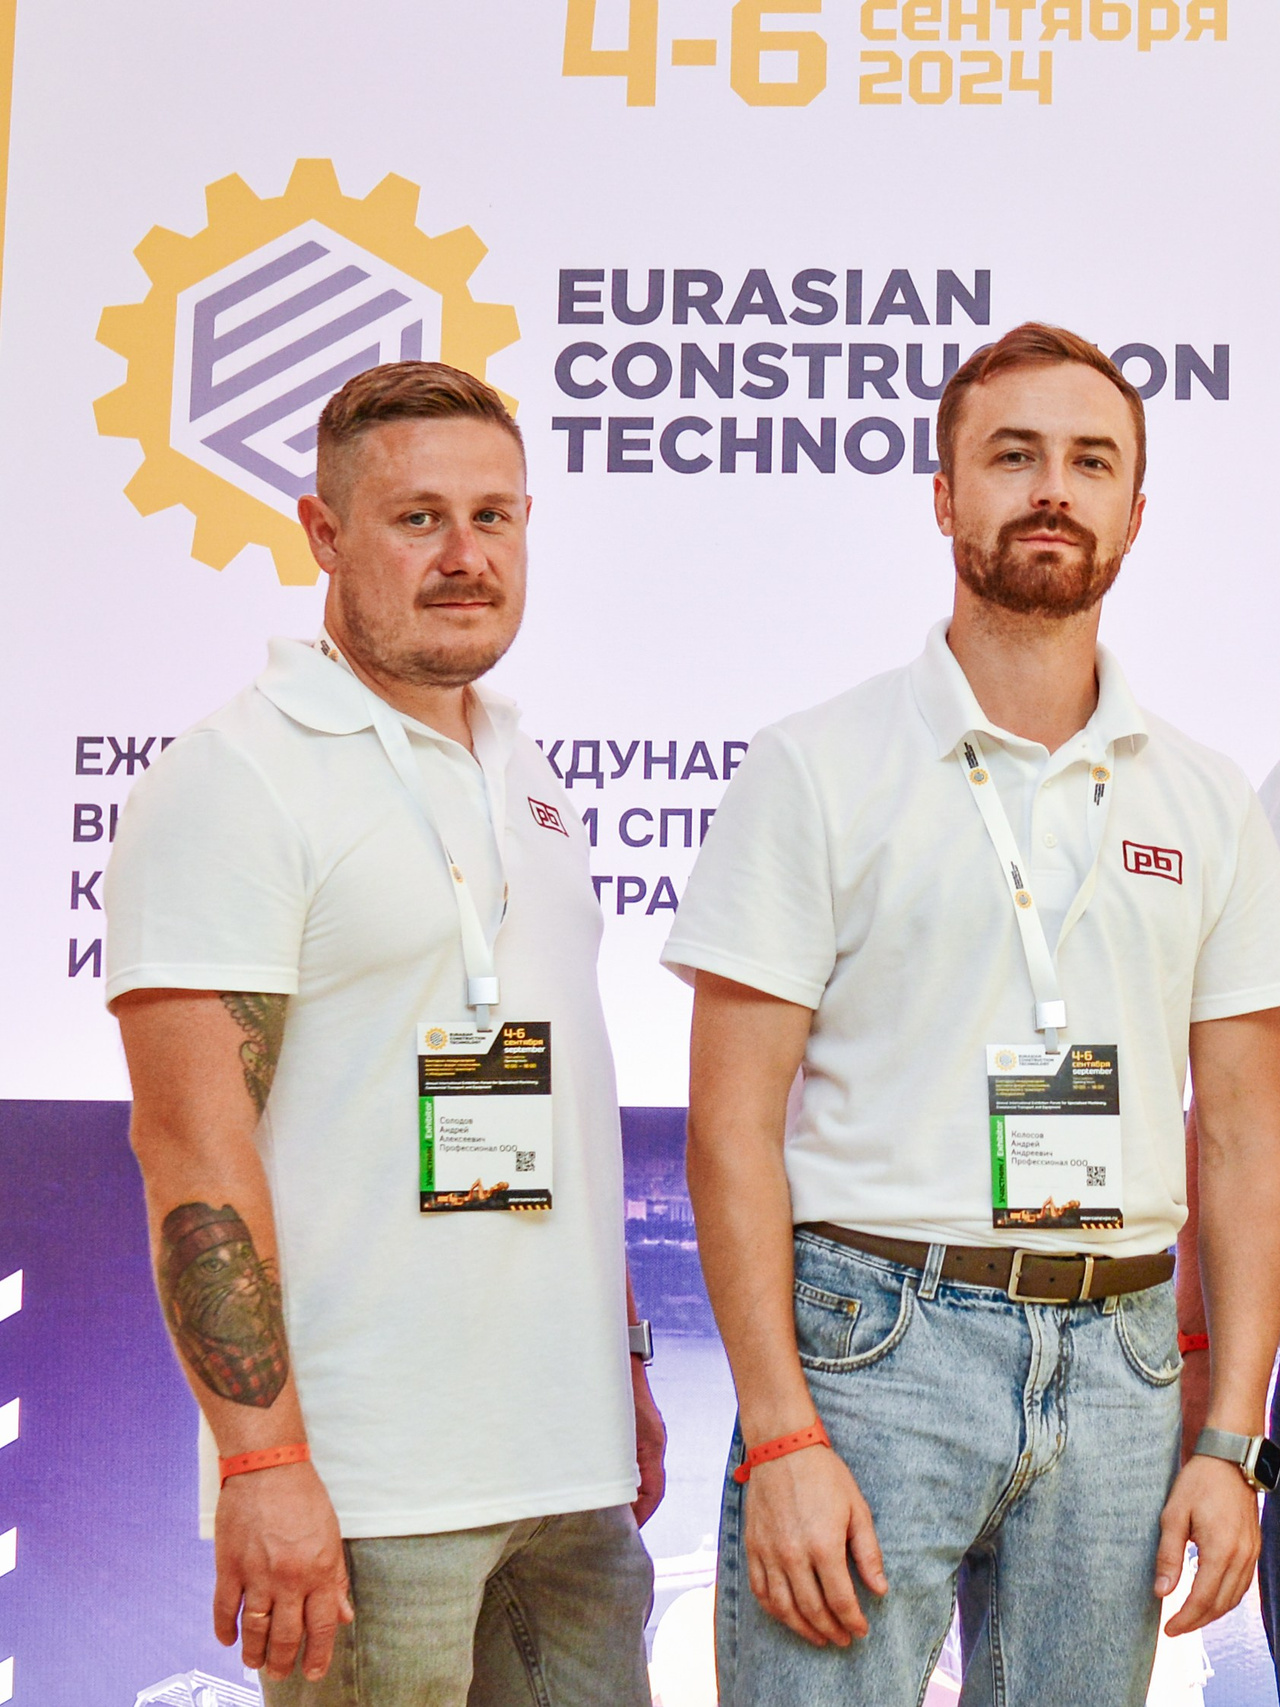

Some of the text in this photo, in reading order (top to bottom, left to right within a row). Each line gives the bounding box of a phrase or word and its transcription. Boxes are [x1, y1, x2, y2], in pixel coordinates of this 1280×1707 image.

[562, 0, 1229, 107] 4-6 сентября
[859, 50, 1052, 105] 2024
[558, 268, 990, 325] EURASIAN
[553, 340, 1230, 401] CONSTRUON
[504, 1028, 525, 1039] 4-6
[503, 1039, 544, 1047] сентября
[1072, 1051, 1092, 1061] 4-6
[1072, 1061, 1111, 1069] сентября
[1072, 1067, 1113, 1076] september
[440, 1117, 473, 1125] Солодов
[440, 1126, 469, 1134] Андрей
[440, 1135, 486, 1143] Алексеевич
[1011, 1131, 1044, 1139] Колосов
[1011, 1140, 1040, 1148] Андрей
[439, 1144, 498, 1153] Профессионал
[1011, 1158, 1068, 1166] Профессионал
